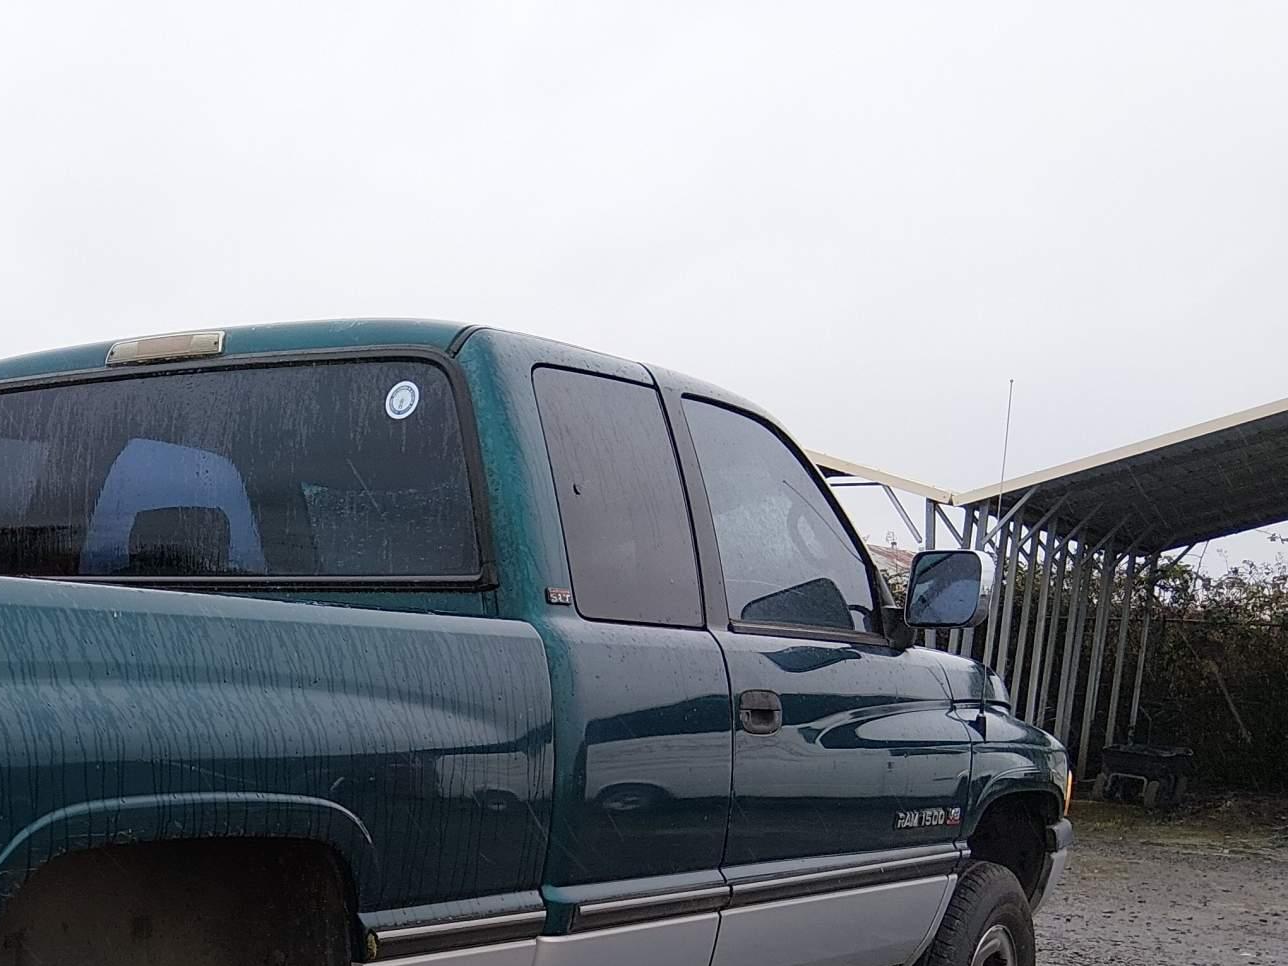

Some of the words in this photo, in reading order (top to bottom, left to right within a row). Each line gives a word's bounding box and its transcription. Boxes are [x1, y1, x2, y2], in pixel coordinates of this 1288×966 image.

[550, 592, 571, 603] SLT
[896, 810, 919, 829] RAM
[921, 808, 945, 827] 1500
